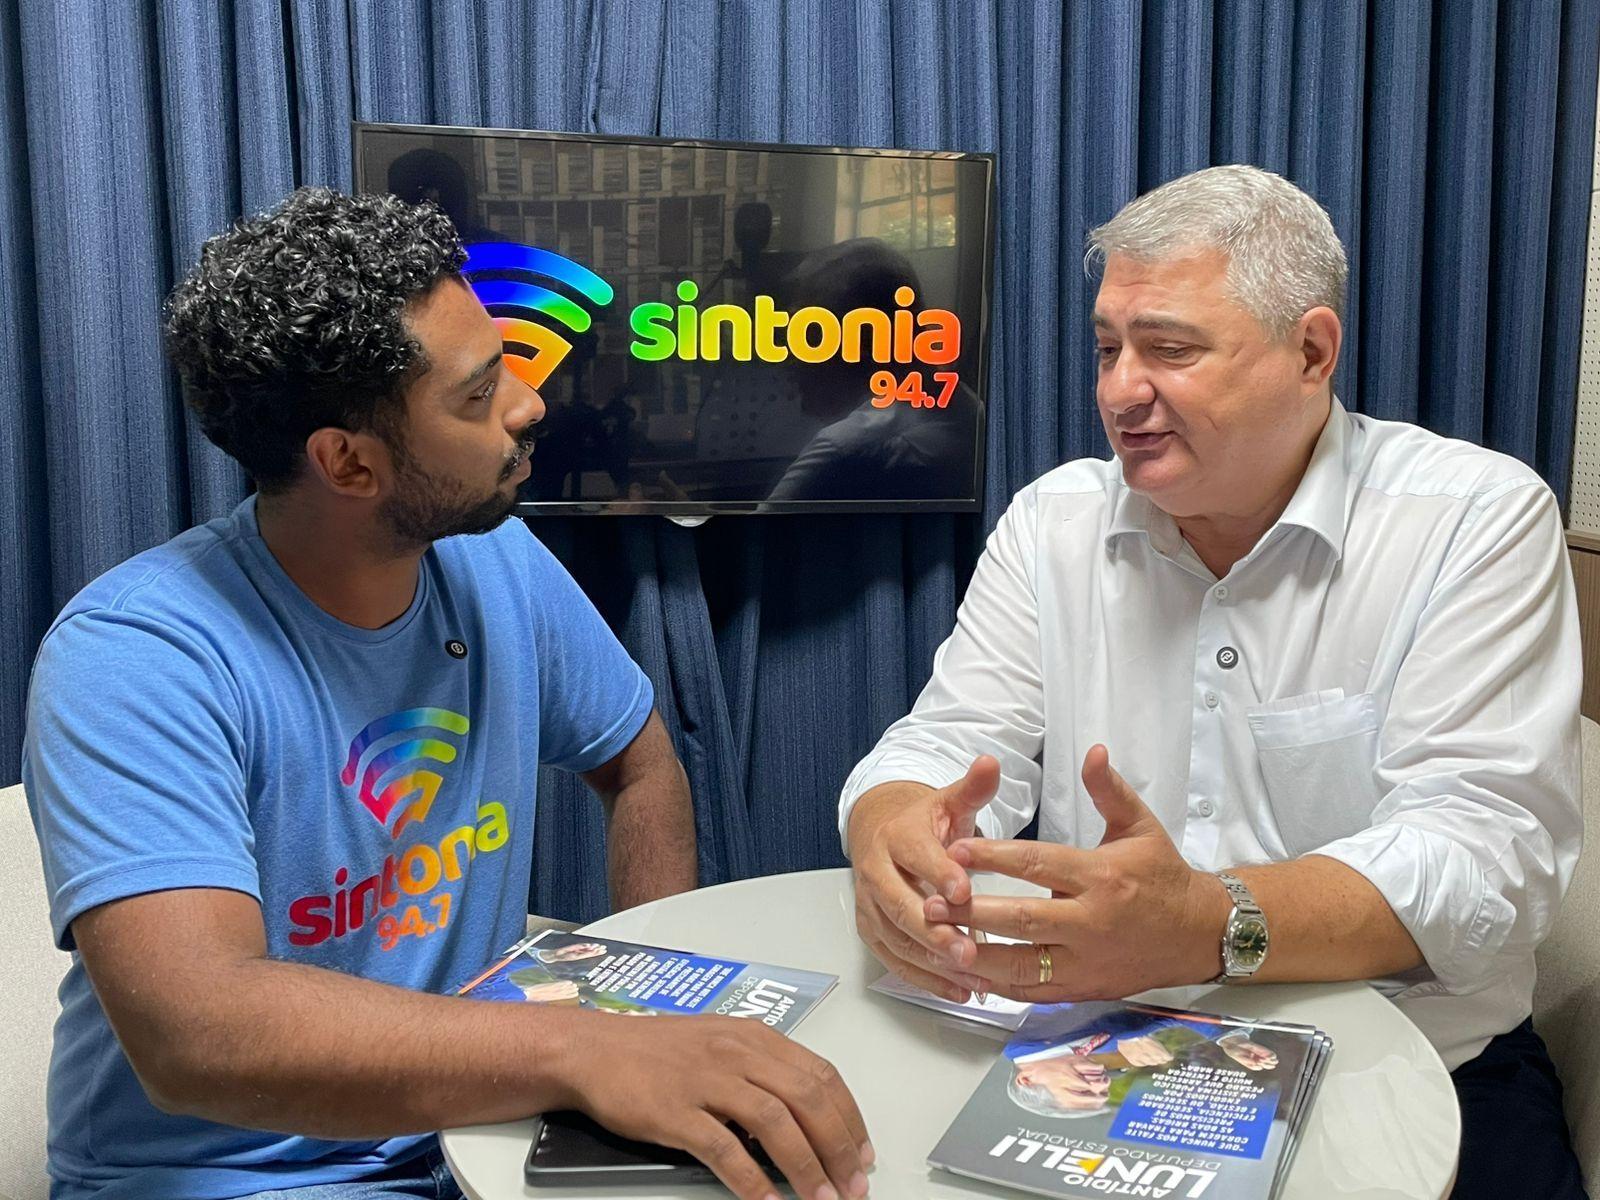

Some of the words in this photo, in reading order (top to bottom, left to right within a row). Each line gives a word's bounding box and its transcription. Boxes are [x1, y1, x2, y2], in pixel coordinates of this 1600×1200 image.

[630, 280, 961, 365] sintonia
[870, 371, 959, 409] 94.7
[288, 801, 510, 946] sintona
[377, 893, 452, 951] 94.7
[715, 976, 759, 1015] DEPUTADO
[1017, 1127, 1109, 1150] ESTADUAL
[989, 1135, 1217, 1199] LUNELLI
[1113, 1147, 1222, 1170] DEPUTADO
[1063, 1173, 1171, 1199] ANTÍDIO
